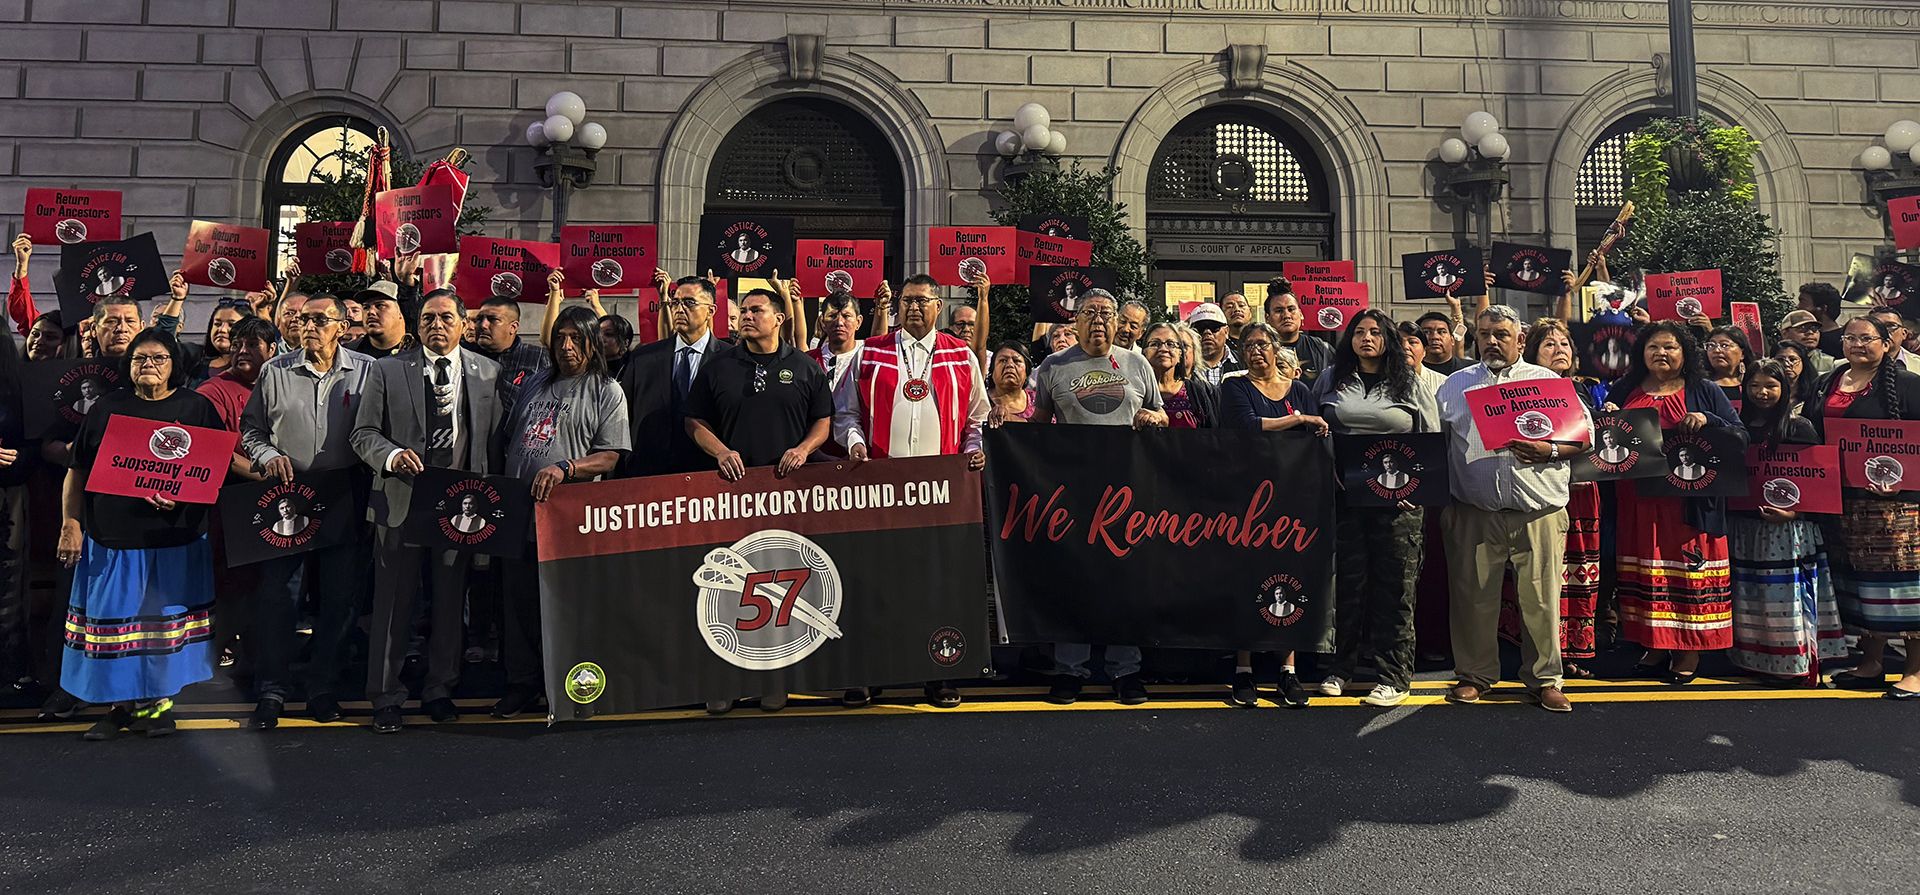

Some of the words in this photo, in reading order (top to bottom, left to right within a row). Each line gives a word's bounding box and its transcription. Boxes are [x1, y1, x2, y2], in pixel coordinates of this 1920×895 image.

[56, 193, 90, 206] Return
[394, 194, 421, 207] Return
[37, 204, 55, 217] Our
[60, 205, 110, 219] Ancestors
[397, 207, 442, 222] Ancestors
[1901, 212, 1920, 223] Our
[212, 228, 240, 243] Return
[590, 230, 623, 243] Return
[724, 221, 753, 238] JUSTICE
[754, 224, 768, 239] FOR
[956, 231, 987, 243] Return
[195, 240, 211, 254] Our
[212, 242, 257, 260] Ancestors
[306, 237, 320, 249] Our
[491, 242, 527, 258] Return
[571, 244, 590, 257] Our
[593, 244, 645, 257] Ancestors
[823, 243, 854, 256] Return
[940, 244, 957, 256] Our
[960, 244, 1006, 256] Ancestors
[1034, 237, 1064, 253] Return
[1180, 244, 1198, 253] U.S.
[1201, 244, 1229, 253] COURT
[1234, 244, 1245, 253] OF
[1250, 245, 1291, 255] APPEALS
[81, 253, 110, 279] JUSTICE
[111, 251, 128, 264] FOR
[470, 254, 491, 268] Our
[494, 257, 549, 273] Ancestors
[721, 252, 745, 272] HICKORY
[746, 253, 768, 272] GROUND
[806, 256, 824, 268] Our
[826, 257, 873, 269] Ancestors
[1018, 246, 1034, 259] Our
[1035, 251, 1080, 267] Ancestors
[1424, 253, 1448, 269] JUSTICE
[1448, 255, 1461, 267] FOR
[1305, 265, 1331, 275] Return
[1052, 270, 1080, 287] JUSTICE
[1080, 274, 1093, 288] FOR
[1447, 277, 1465, 293] ROUND
[1670, 276, 1698, 287] Return
[1315, 285, 1343, 295] Return
[1656, 287, 1672, 298] Our
[1676, 285, 1715, 297] Ancestors
[1301, 295, 1318, 306] Our
[1320, 296, 1360, 307] Ancestors
[59, 363, 101, 386] JUSTICE
[101, 366, 120, 384] FOR
[1499, 385, 1541, 400] Return
[1484, 404, 1506, 417] Our
[1510, 397, 1569, 412] Ancestors
[1594, 416, 1616, 431] STICE
[1618, 418, 1633, 434] FOR
[1860, 423, 1903, 439] Return
[1364, 440, 1399, 460] JUSTICE
[1399, 443, 1416, 460] FOR
[1694, 434, 1713, 453] FOR
[1839, 438, 1863, 452] Our
[1866, 439, 1920, 456] Ancestor
[1588, 453, 1618, 473] HICKORY
[1618, 449, 1640, 473] GROUND
[1758, 449, 1799, 463] Return
[111, 455, 183, 479] Ancestors
[186, 465, 211, 483] Our
[1764, 463, 1826, 479] Ancestors
[135, 475, 182, 496] Return
[1365, 476, 1394, 500] HICKORY
[1395, 476, 1421, 500] GROUND
[1665, 473, 1692, 491] ICKORY
[1693, 468, 1718, 490] GROUND
[257, 482, 296, 509] JUSTICE
[297, 483, 316, 500] FOR
[446, 479, 485, 498] JUSTICE
[484, 485, 502, 504] FOR
[999, 483, 1075, 543] We
[1087, 480, 1319, 558] Remember
[258, 527, 293, 549] HICKORY
[294, 518, 322, 546] GROUND
[438, 516, 465, 544] HICKORY
[466, 522, 498, 545] GROUND
[1261, 573, 1289, 592] JUSTICE
[1288, 576, 1303, 592] FOR
[735, 568, 812, 631] 57
[1282, 606, 1305, 627] GROUND
